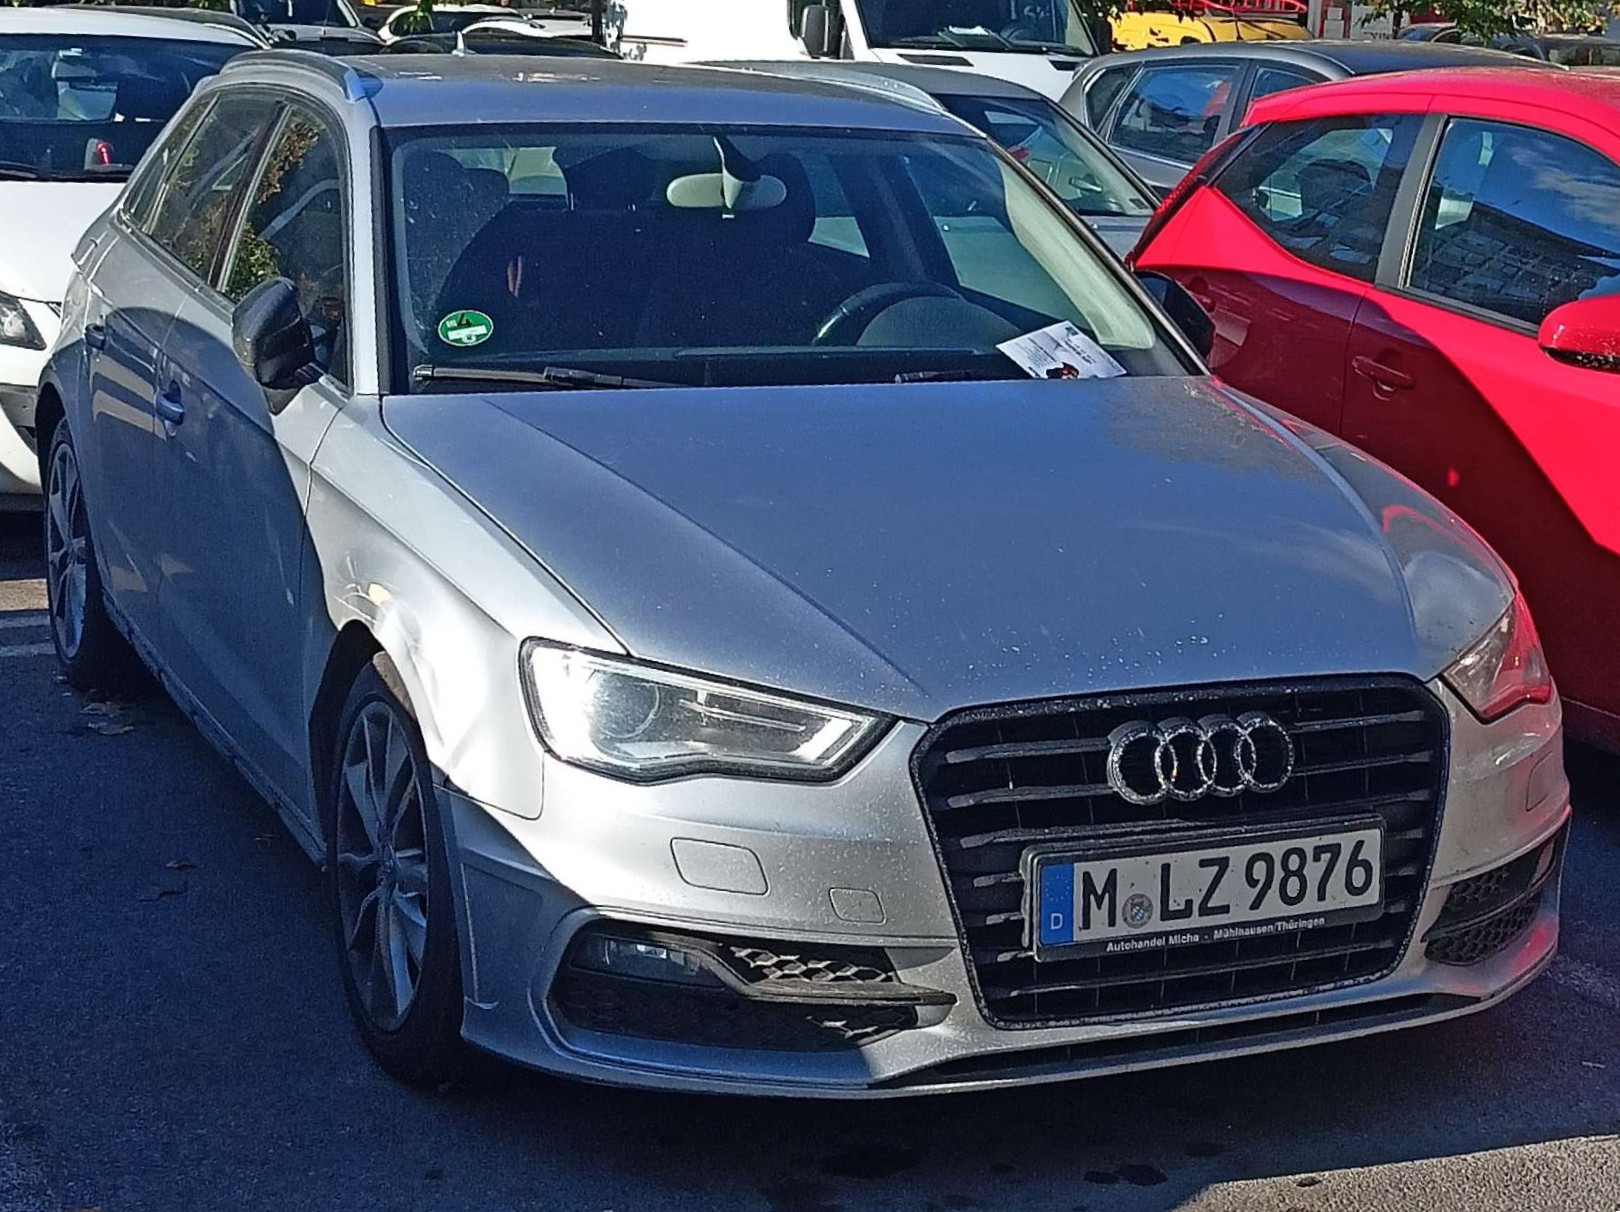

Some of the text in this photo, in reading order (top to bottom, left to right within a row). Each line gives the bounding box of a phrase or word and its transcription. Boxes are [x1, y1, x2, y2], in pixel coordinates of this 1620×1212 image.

[457, 313, 472, 327] 4
[1082, 840, 1373, 930] M LZ 9876
[1050, 913, 1063, 930] D
[1106, 937, 1165, 952] Autohandel
[1168, 933, 1200, 945] Micha
